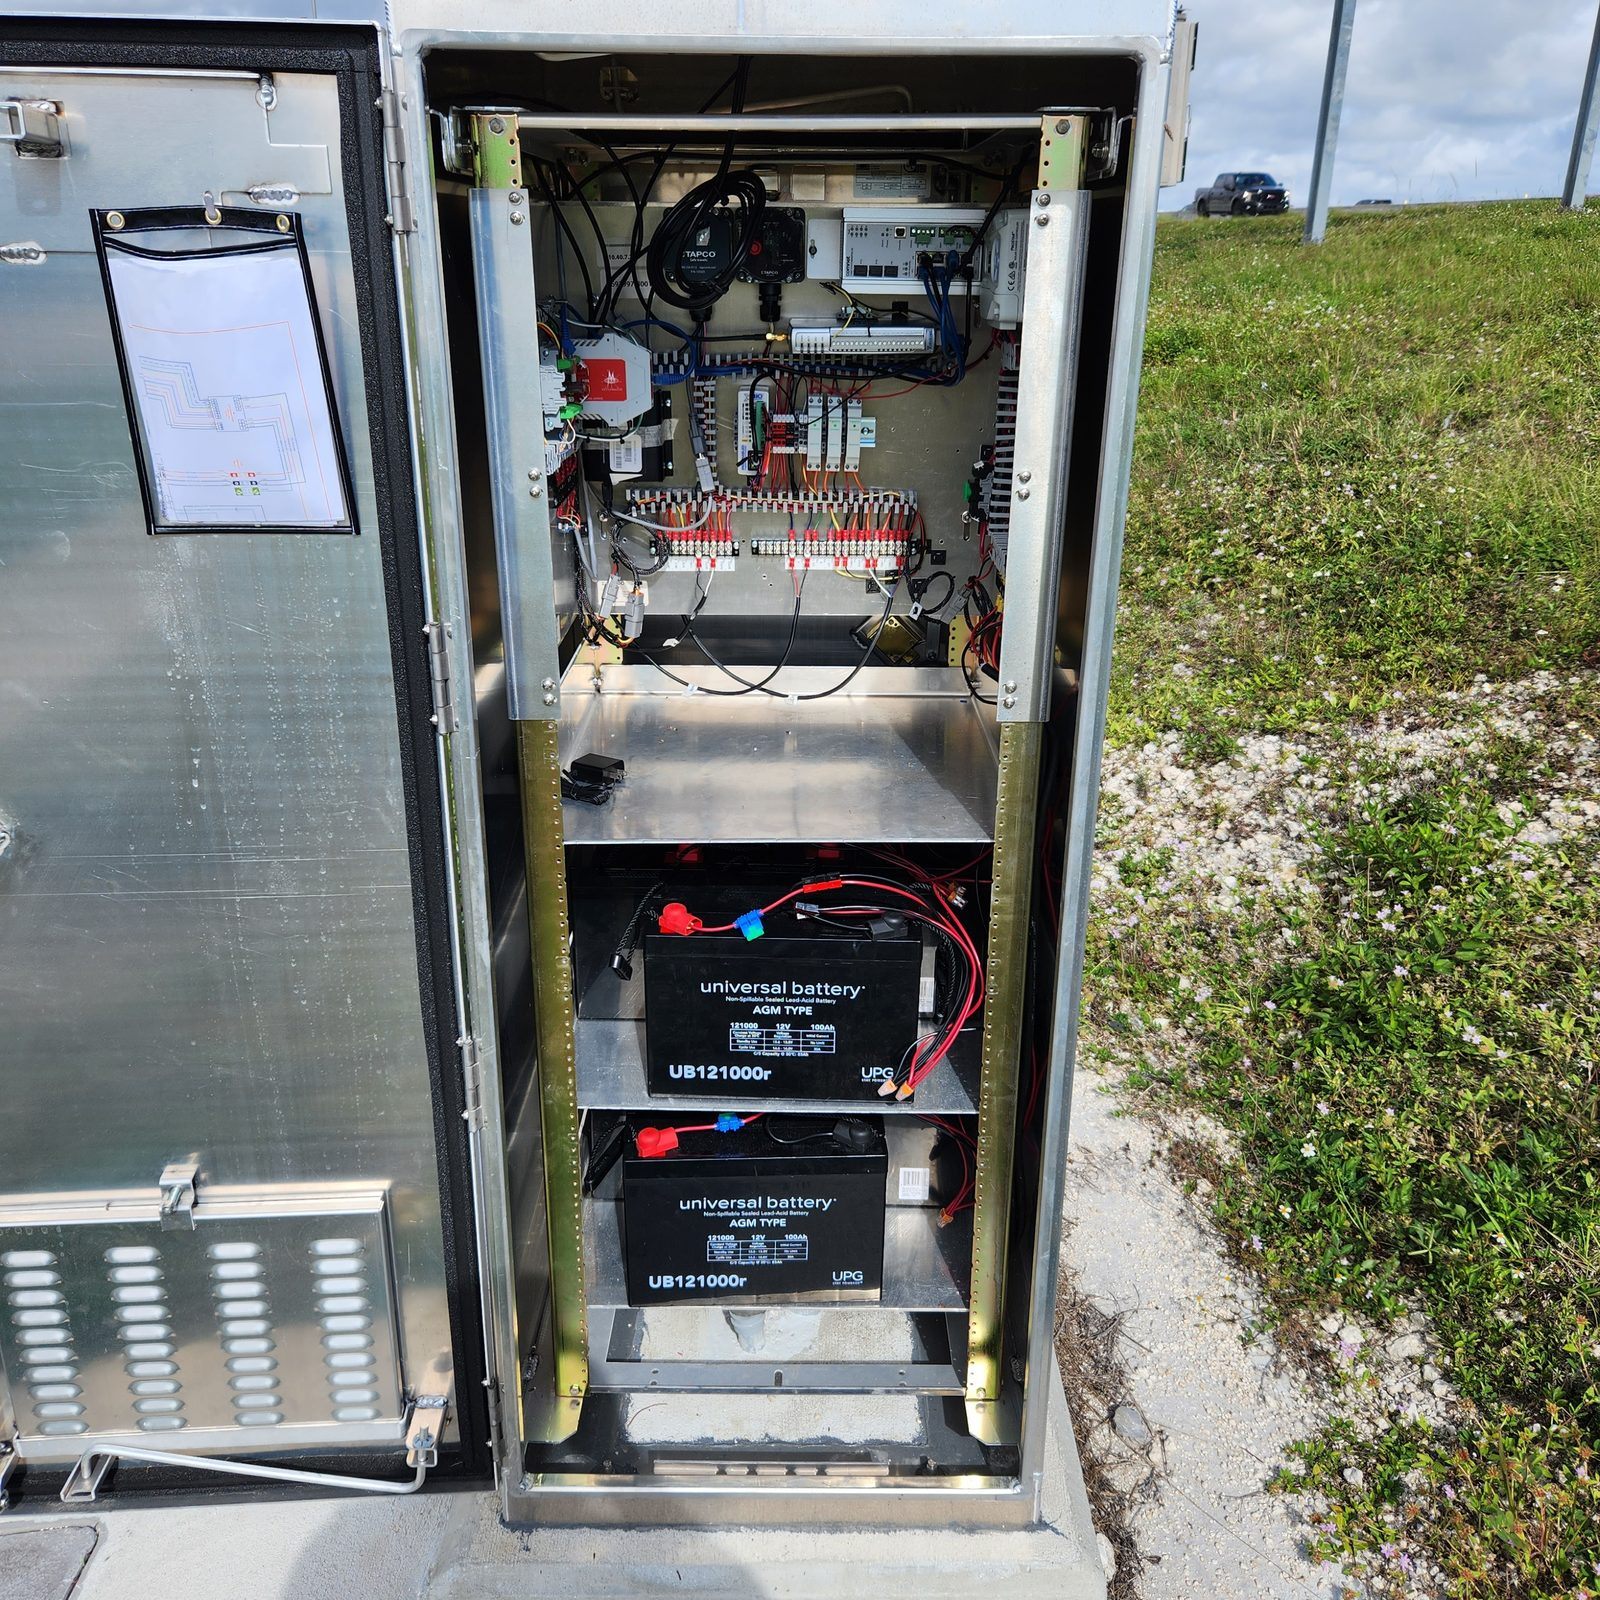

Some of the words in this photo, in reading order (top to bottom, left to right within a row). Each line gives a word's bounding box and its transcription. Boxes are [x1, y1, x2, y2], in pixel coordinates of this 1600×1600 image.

[685, 250, 716, 258] TAPCO
[701, 980, 787, 995] universal
[792, 981, 861, 1000] battery
[753, 1005, 781, 1015] AGM
[784, 1006, 813, 1016] TYPE
[669, 1064, 771, 1081] UB121000r
[861, 1066, 894, 1079] UPG
[680, 1196, 762, 1210] universal
[767, 1196, 832, 1211] battery
[729, 1218, 757, 1228] AGM
[759, 1218, 786, 1227] TYPE
[649, 1274, 748, 1289] UB121000r
[832, 1270, 864, 1281] UPG
